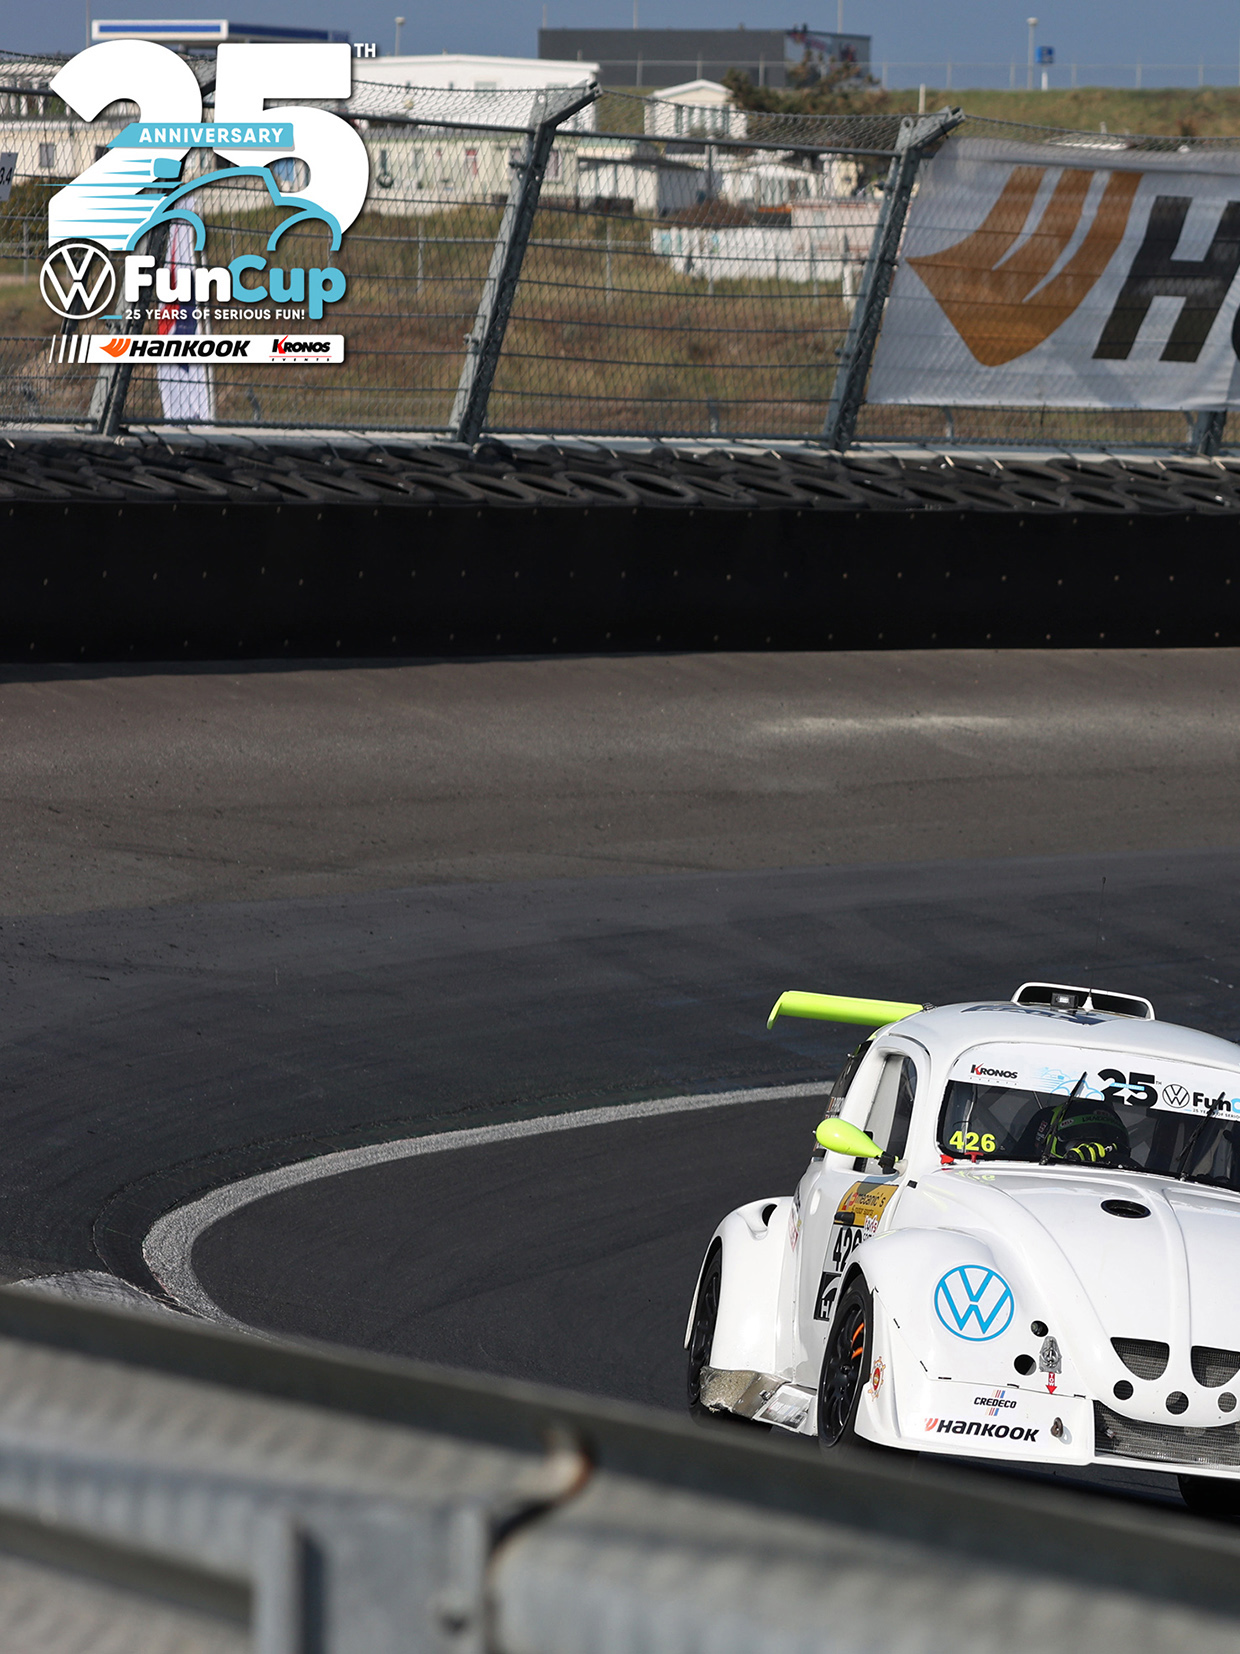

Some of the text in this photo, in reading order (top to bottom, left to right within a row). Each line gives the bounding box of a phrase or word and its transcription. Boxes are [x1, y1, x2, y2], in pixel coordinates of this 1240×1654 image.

[969, 1062, 1019, 1079] KRONOS
[1097, 1068, 1158, 1108] 25
[949, 1130, 996, 1153] 426
[973, 1396, 1018, 1409] CREDECO
